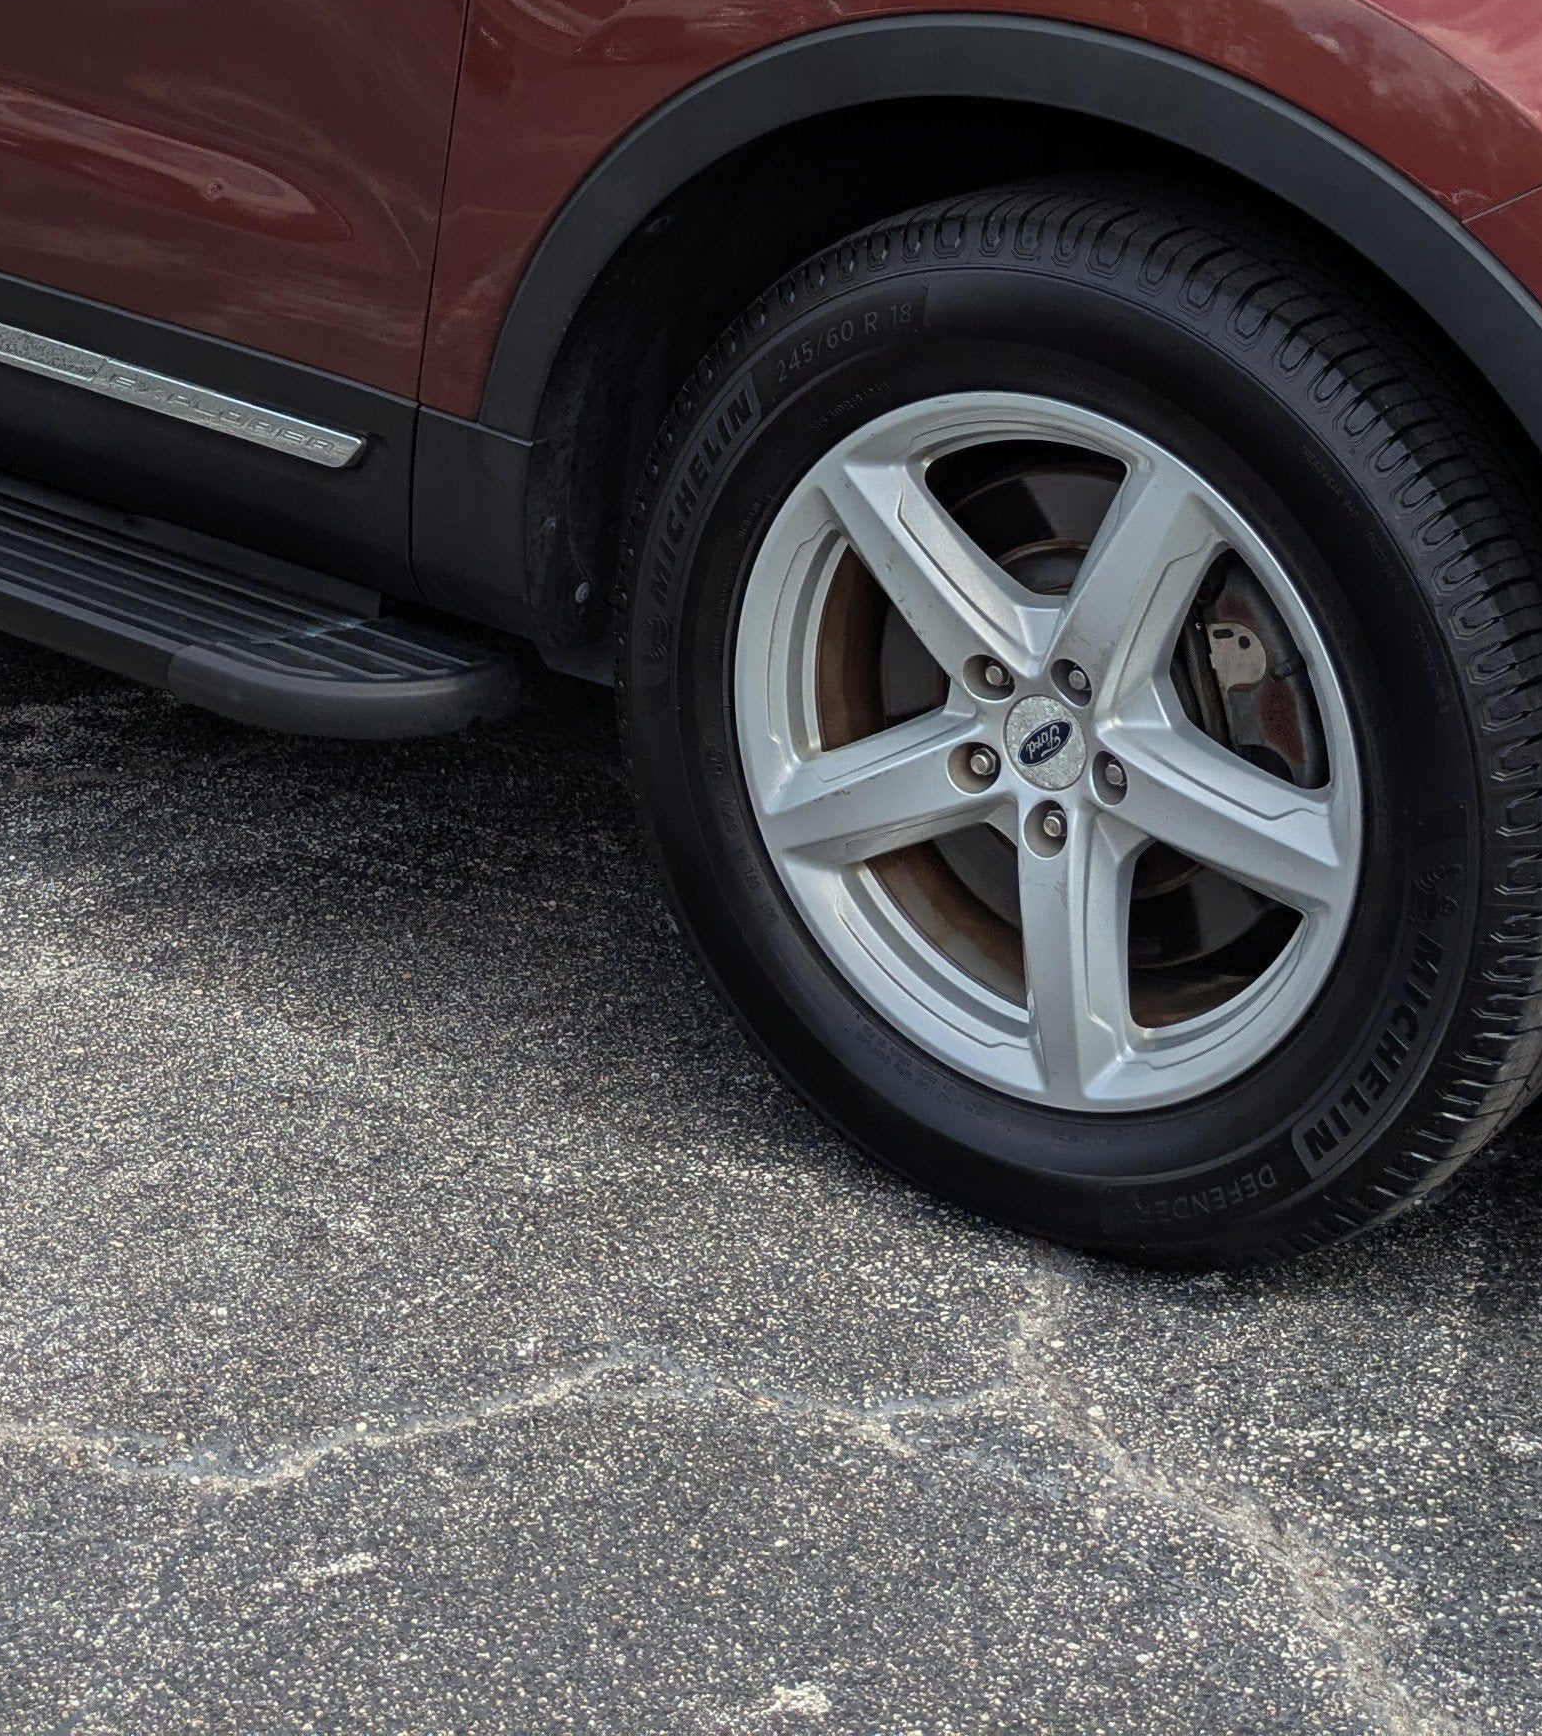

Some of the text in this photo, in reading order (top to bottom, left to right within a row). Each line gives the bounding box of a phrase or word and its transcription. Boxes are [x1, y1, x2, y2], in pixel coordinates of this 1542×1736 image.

[775, 301, 913, 383] 245/60 R 18
[109, 371, 345, 457] EXPLORER
[651, 387, 754, 607] MICHELIN
[1024, 723, 1062, 761] Ford
[1302, 931, 1445, 1162] MICHELIN
[1135, 1163, 1278, 1223] DEFENDER
